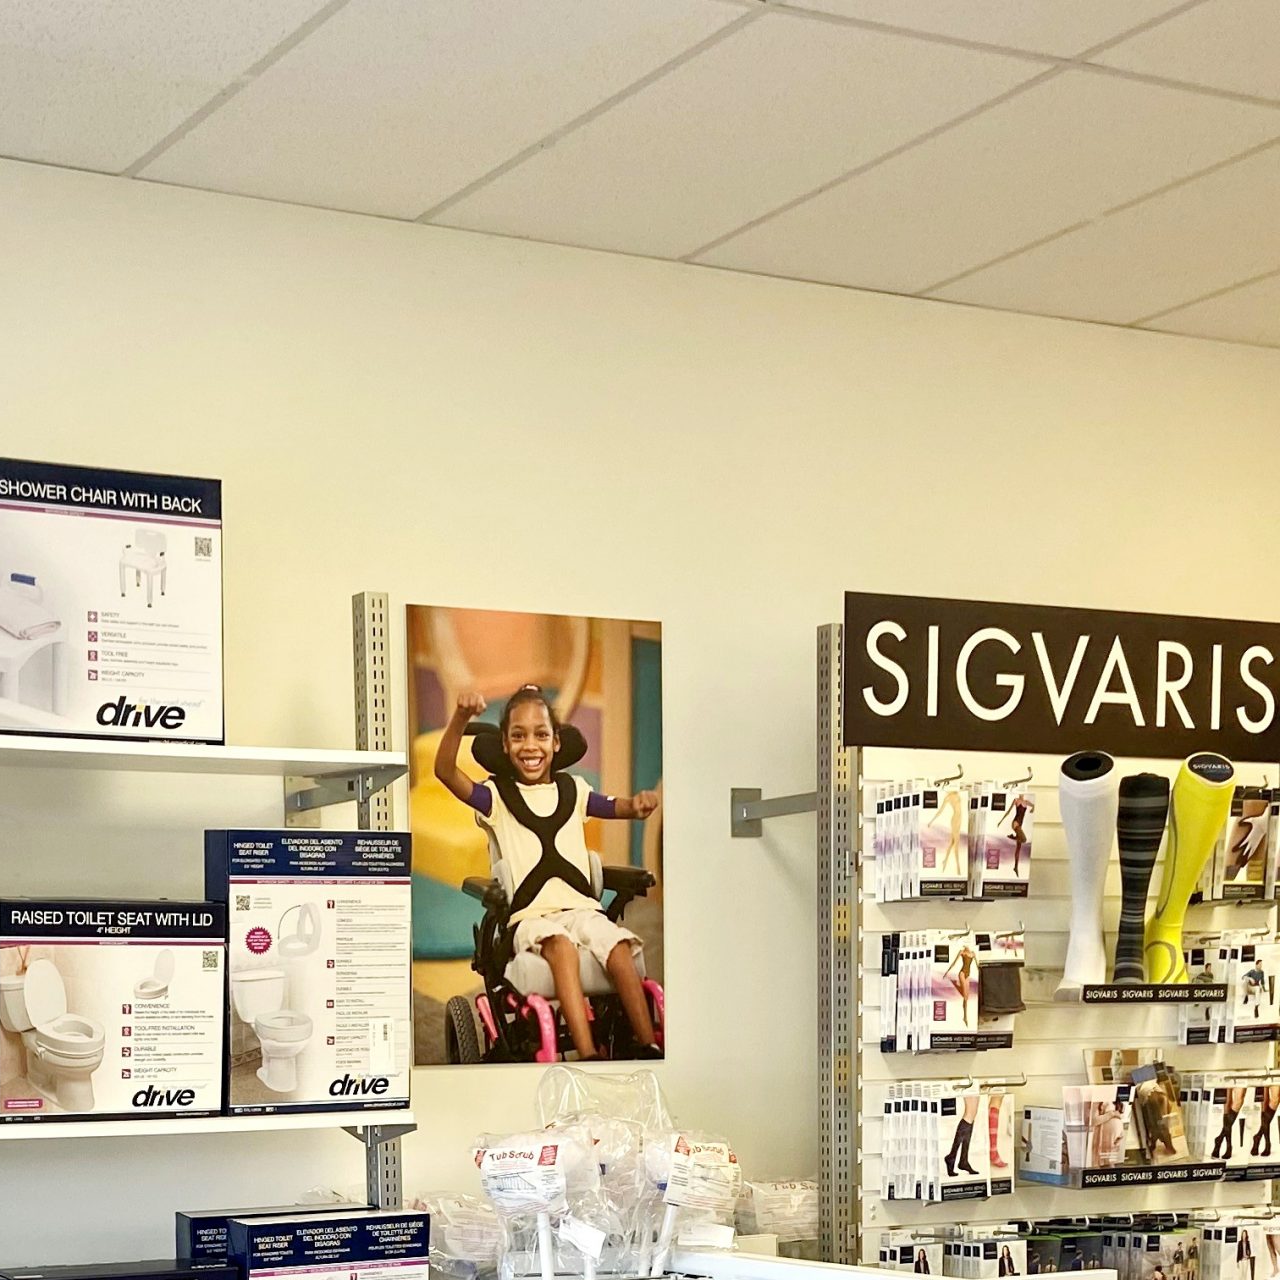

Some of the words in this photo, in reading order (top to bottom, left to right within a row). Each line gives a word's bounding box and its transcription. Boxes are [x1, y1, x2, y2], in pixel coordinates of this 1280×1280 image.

[71, 487, 117, 506] CHAIR
[120, 492, 158, 509] WITH
[162, 496, 202, 514] BACK
[862, 620, 1276, 735] SIGVARIS
[96, 696, 186, 729] drive
[12, 911, 63, 925] RAISED
[66, 911, 115, 926] TOILET
[117, 913, 151, 926] SEAT
[155, 913, 189, 926] WITH
[192, 914, 213, 926] LID
[1122, 990, 1154, 998] SIGVARIS
[1194, 989, 1224, 997] SIGVARIS
[328, 1074, 389, 1096] drive
[132, 1085, 195, 1108] drive
[489, 1150, 508, 1162] Tub
[509, 1150, 534, 1161] Scrub
[1085, 1173, 1117, 1183] SIGVARIS
[1121, 1172, 1153, 1182] SIGVARIS
[1157, 1170, 1188, 1179] SIGVARIS
[1193, 1168, 1222, 1178] SIGVARIS
